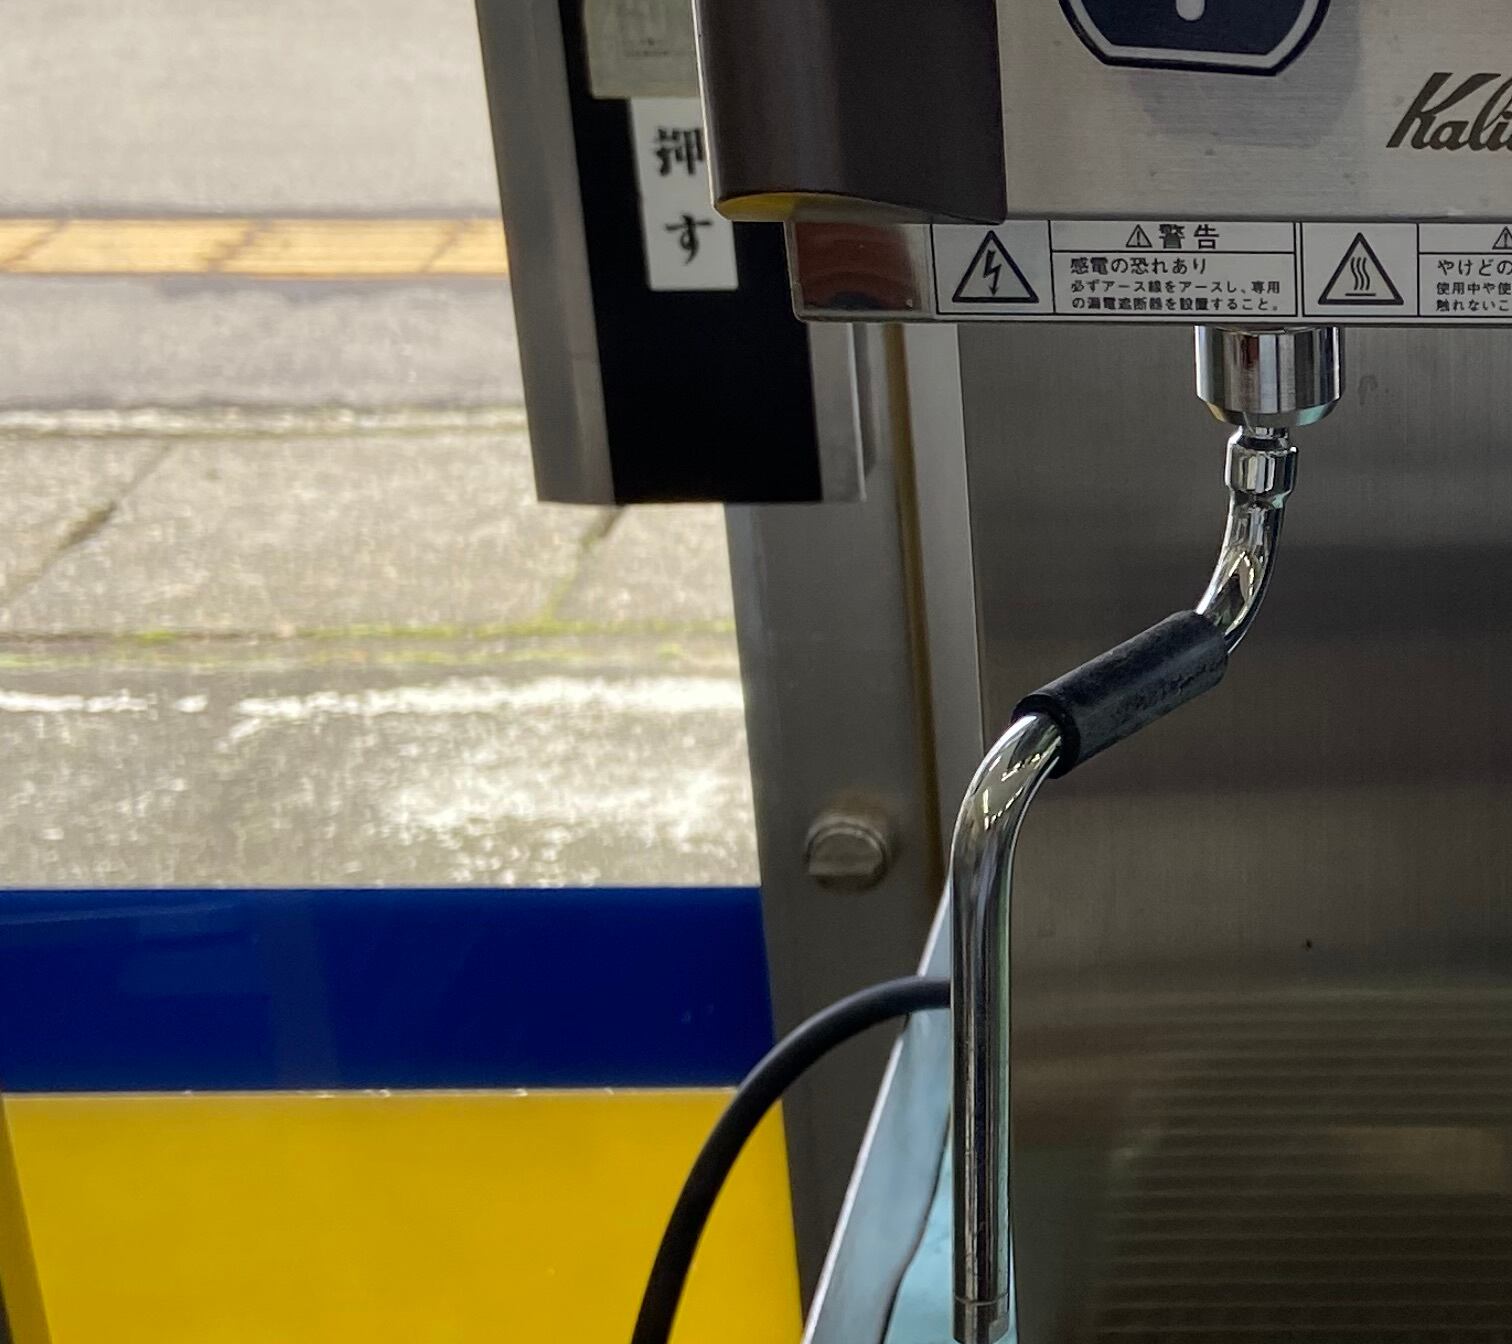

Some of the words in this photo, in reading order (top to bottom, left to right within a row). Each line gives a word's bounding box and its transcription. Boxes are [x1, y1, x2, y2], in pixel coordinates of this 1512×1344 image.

[1159, 224, 1220, 250] 警告
[1070, 257, 1207, 275] 感電の恐れあり
